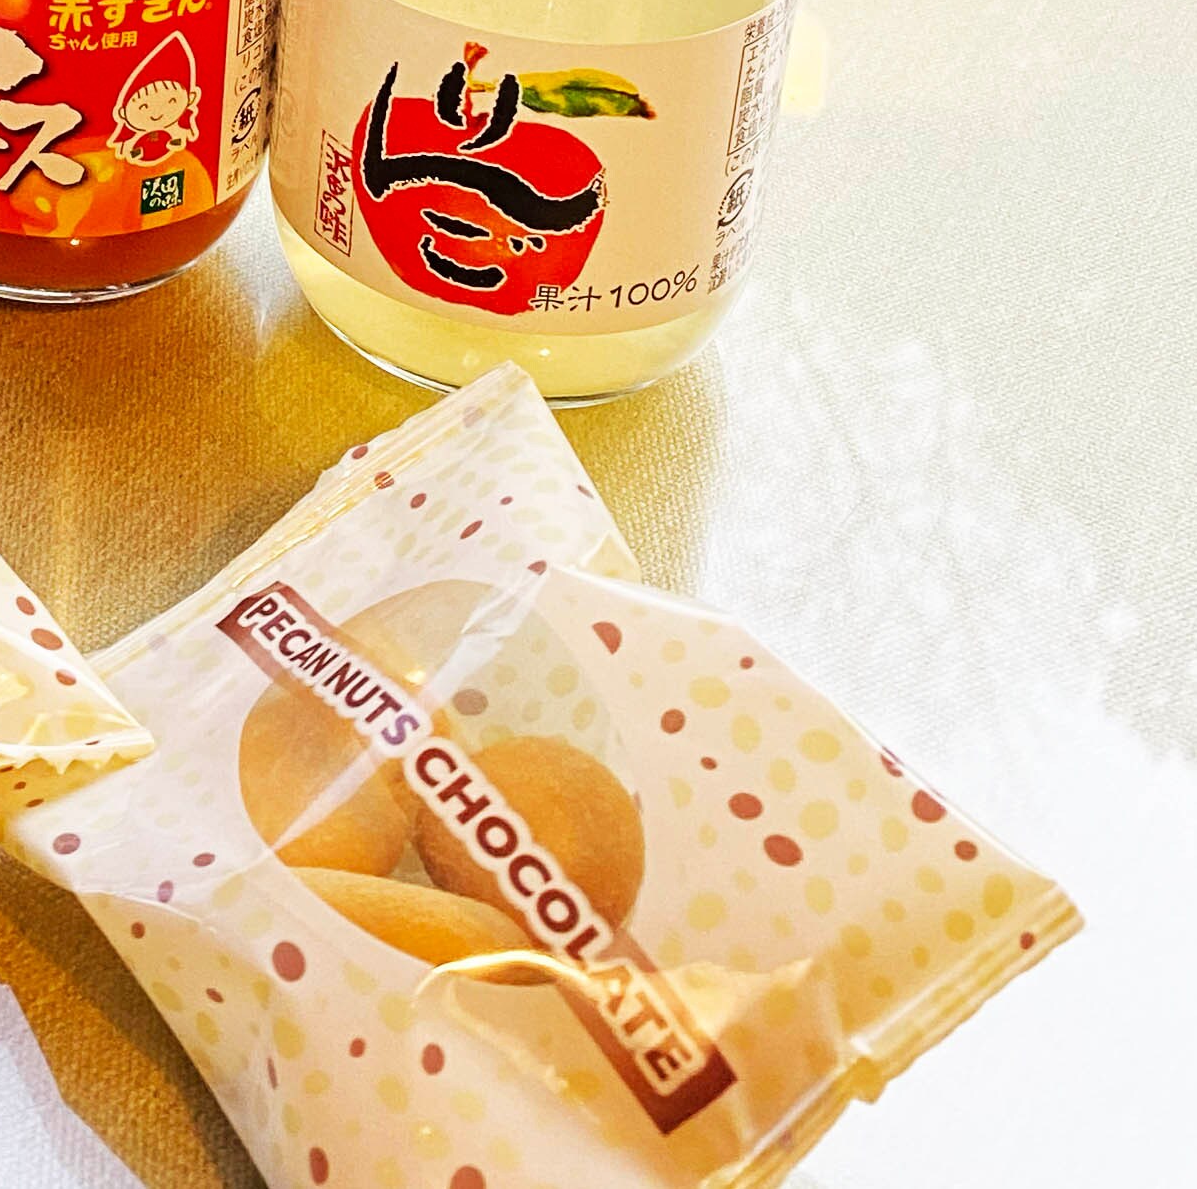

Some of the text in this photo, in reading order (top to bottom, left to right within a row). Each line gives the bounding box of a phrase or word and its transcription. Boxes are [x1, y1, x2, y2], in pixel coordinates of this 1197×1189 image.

[48, 31, 138, 52] ちゃん使用
[237, 100, 255, 130] 紙
[363, 61, 605, 288] りんご
[726, 181, 746, 214] 紙
[530, 285, 602, 312] 果汁
[610, 263, 700, 309] 100%
[245, 597, 693, 1081] PECAN NUTS CHOCOLATE
